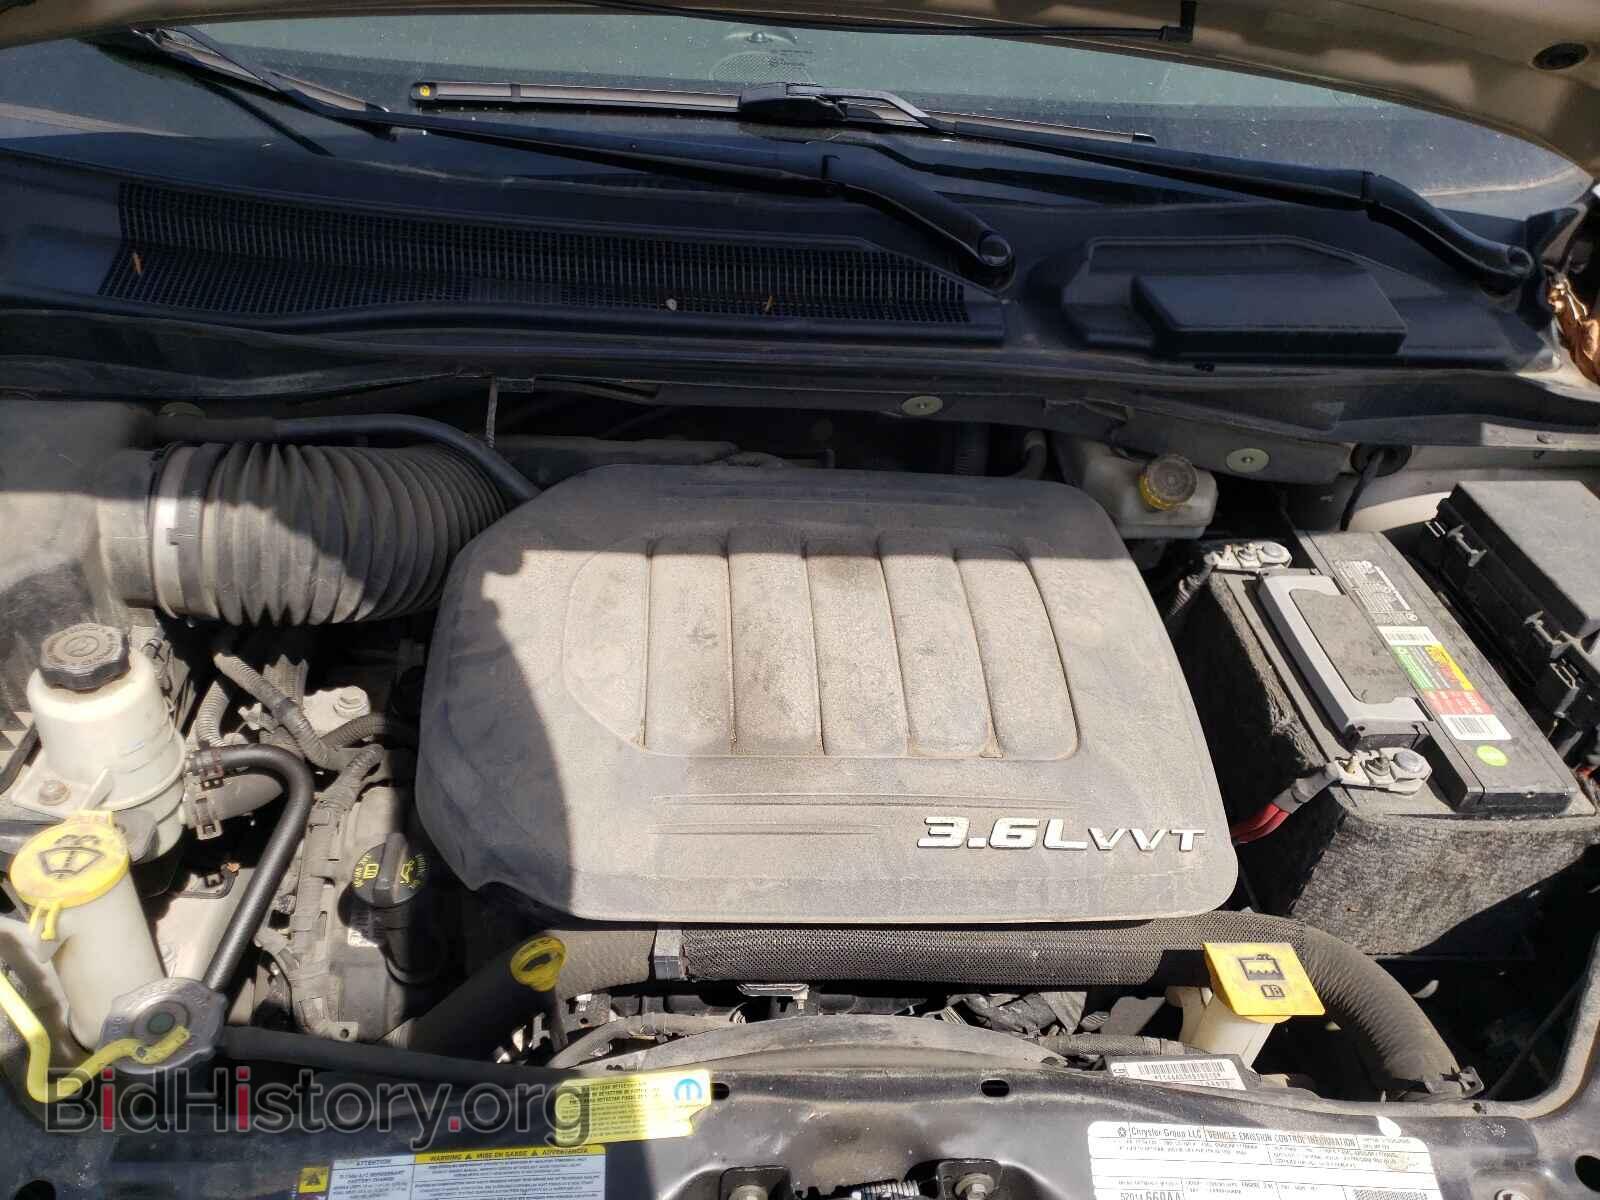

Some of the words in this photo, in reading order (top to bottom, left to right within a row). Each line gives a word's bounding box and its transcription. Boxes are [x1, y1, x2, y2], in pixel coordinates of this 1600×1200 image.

[917, 816, 1088, 850] 3.6L
[1088, 828, 1206, 851] VVT
[1131, 1126, 1161, 1138] Chrysler
[1163, 1128, 1186, 1139] Group
[1188, 1129, 1201, 1139] LLC
[1208, 1130, 1236, 1140] VEHICLE
[1238, 1132, 1273, 1142] EMISSION
[1274, 1134, 1305, 1144] CONTROL
[1307, 1135, 1356, 1147] INFORMATION
[430, 1153, 462, 1162] WARNING
